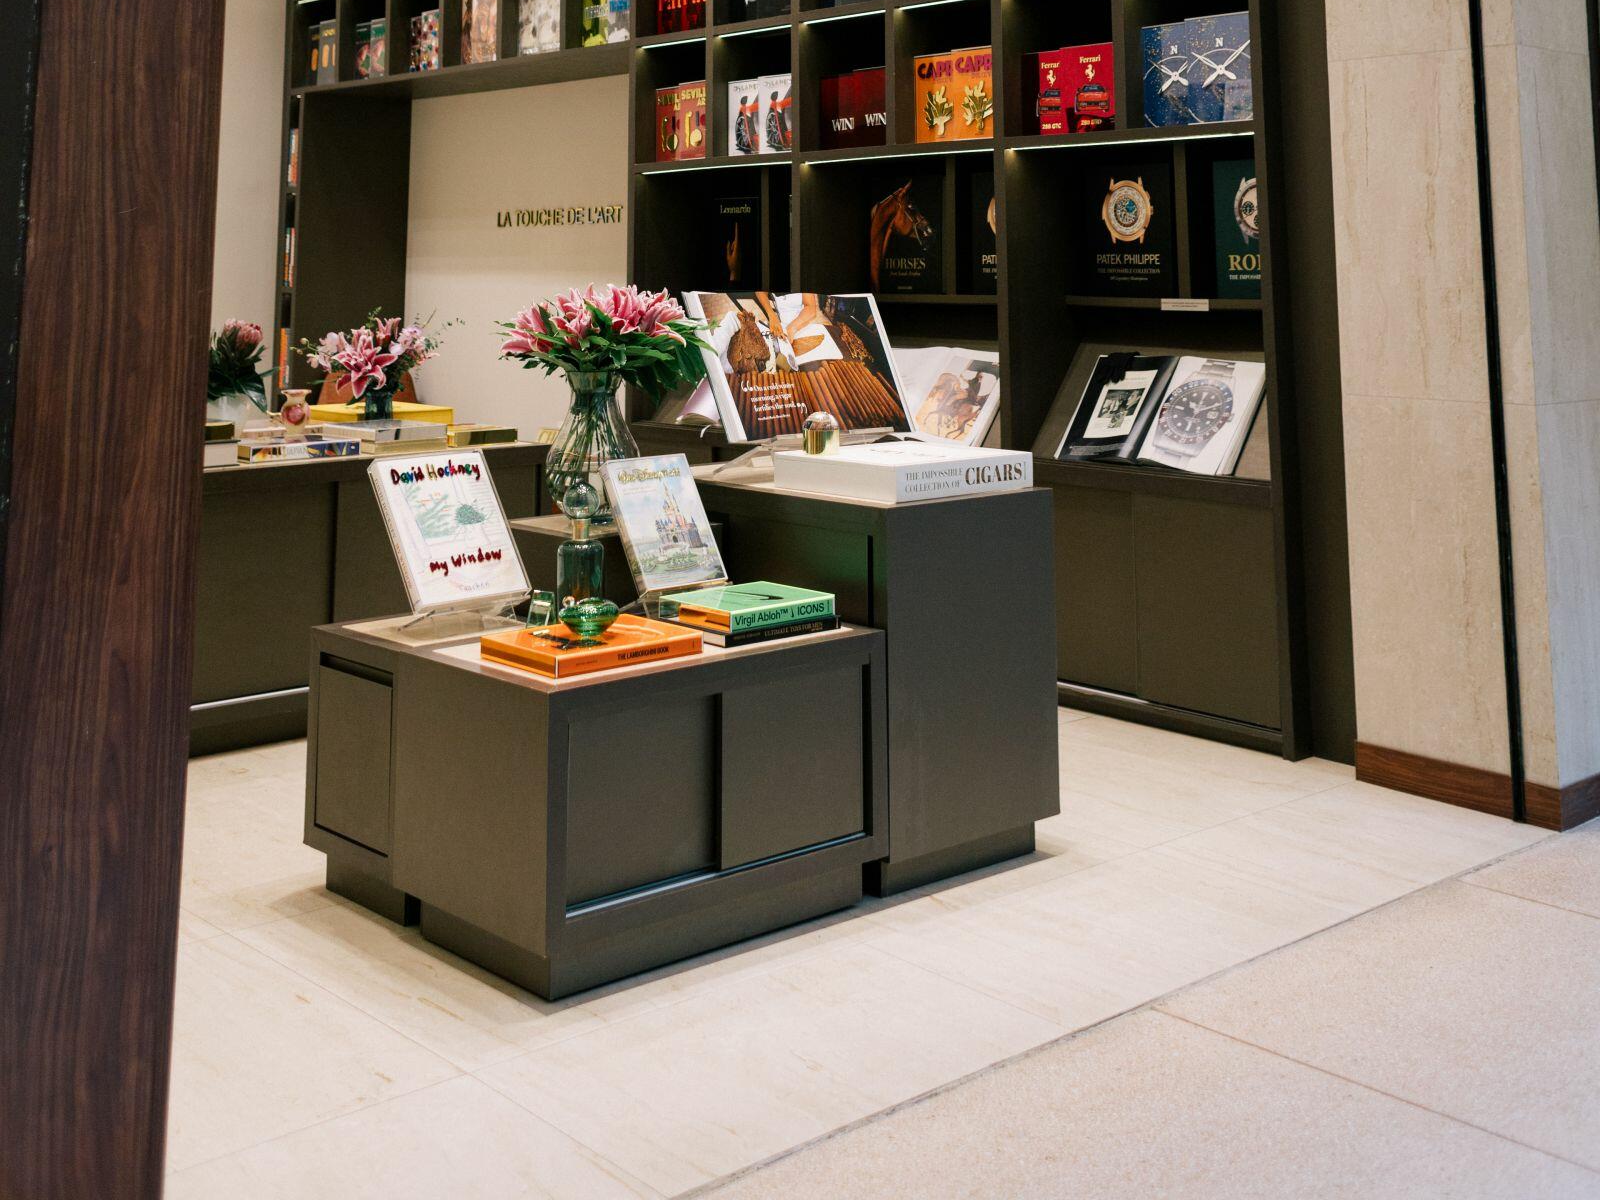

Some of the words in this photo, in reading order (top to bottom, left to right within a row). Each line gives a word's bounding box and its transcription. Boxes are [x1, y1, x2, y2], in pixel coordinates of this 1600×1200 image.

[1215, 37, 1224, 48] N
[1170, 45, 1178, 55] N
[954, 54, 992, 74] CAPR
[1041, 61, 1060, 69] Ferrar
[1079, 54, 1101, 64] Ferrari
[832, 117, 855, 132] WIN
[865, 112, 887, 127] WIN
[720, 203, 751, 214] Leonardo
[497, 211, 512, 228] LA
[515, 208, 565, 227] TOUCHE
[567, 206, 585, 225] DE
[587, 204, 624, 224] L'ART
[885, 257, 926, 270] HORSES
[982, 254, 998, 265] PAT
[1096, 254, 1122, 265] PATEK
[1123, 253, 1161, 265] PHILIPPE
[391, 466, 425, 485] David
[426, 459, 481, 480] Hockney
[906, 471, 920, 481] THE
[921, 467, 964, 480] IMPOSSIBLE
[965, 462, 1023, 486] CIGARS
[905, 482, 950, 493] COLLECTION
[951, 480, 961, 489] OF
[735, 612, 756, 627] Virgil
[797, 602, 825, 616] ICONS
[617, 653, 626, 661] THE
[626, 648, 656, 660] LAMBORGHINI
[657, 646, 669, 655] BOOK
